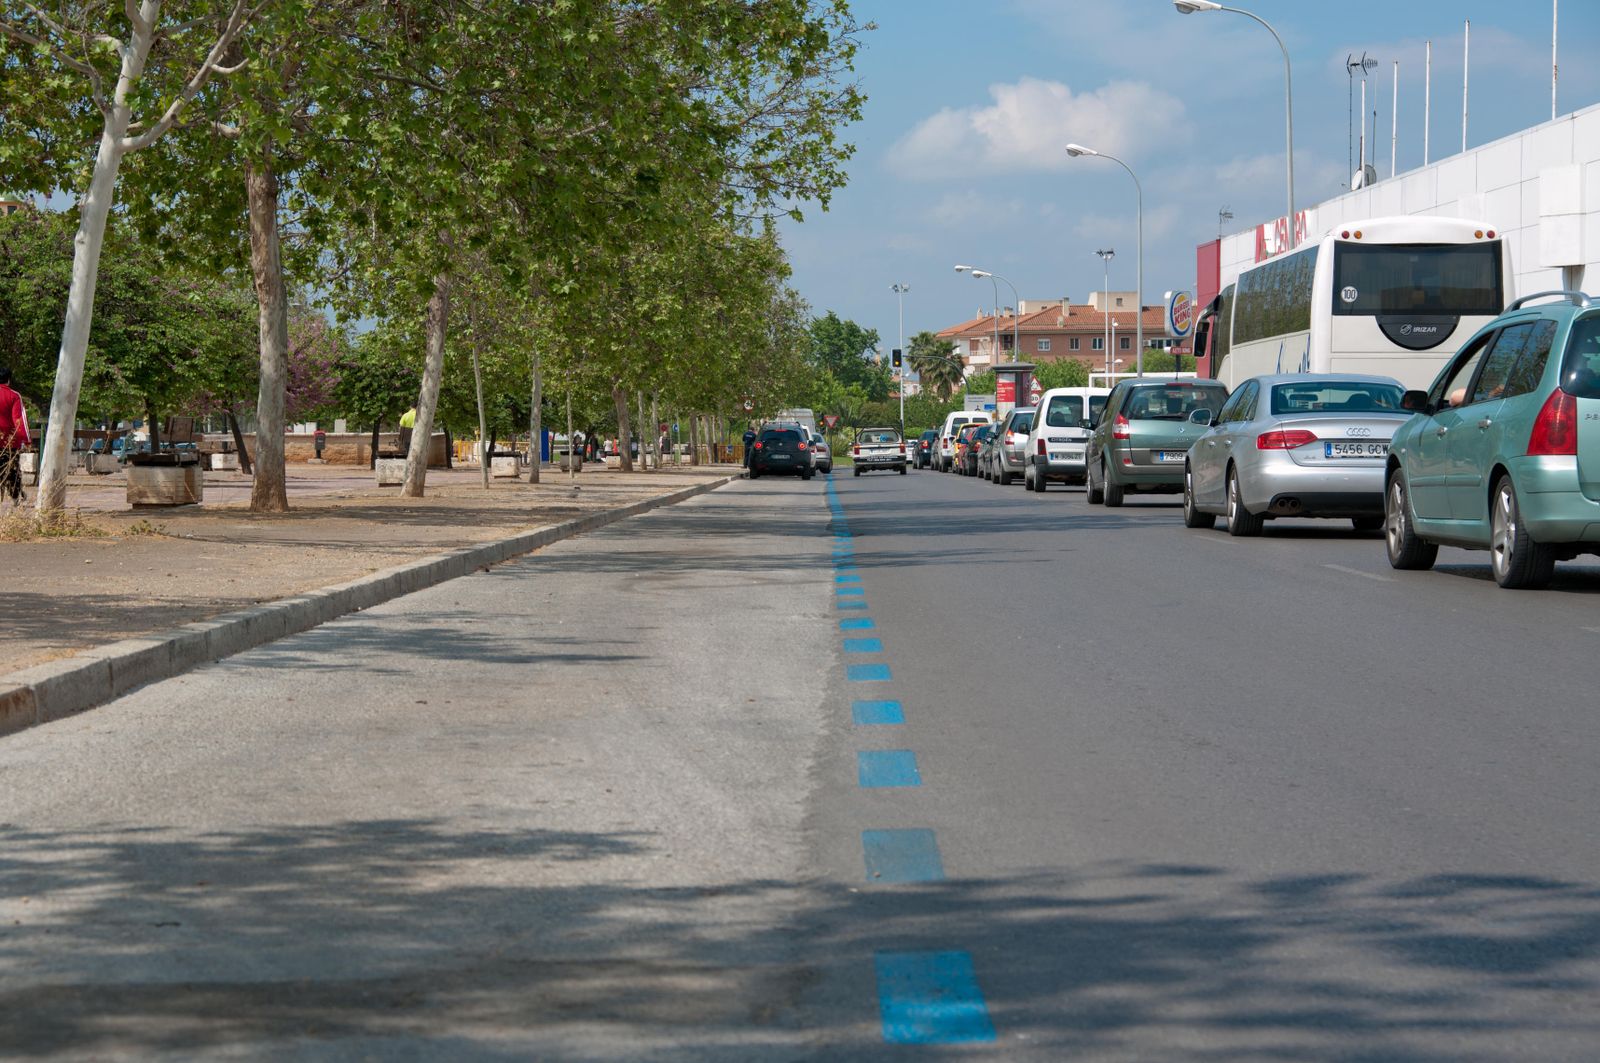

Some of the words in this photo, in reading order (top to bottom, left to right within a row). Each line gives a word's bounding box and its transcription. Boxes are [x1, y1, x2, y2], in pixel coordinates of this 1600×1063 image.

[1343, 288, 1356, 300] 100
[1174, 308, 1191, 326] KING
[1413, 326, 1438, 334] IRIZAR
[1335, 444, 1362, 455] 5456
[1368, 444, 1389, 455] GCW
[1165, 452, 1183, 460] 7909
